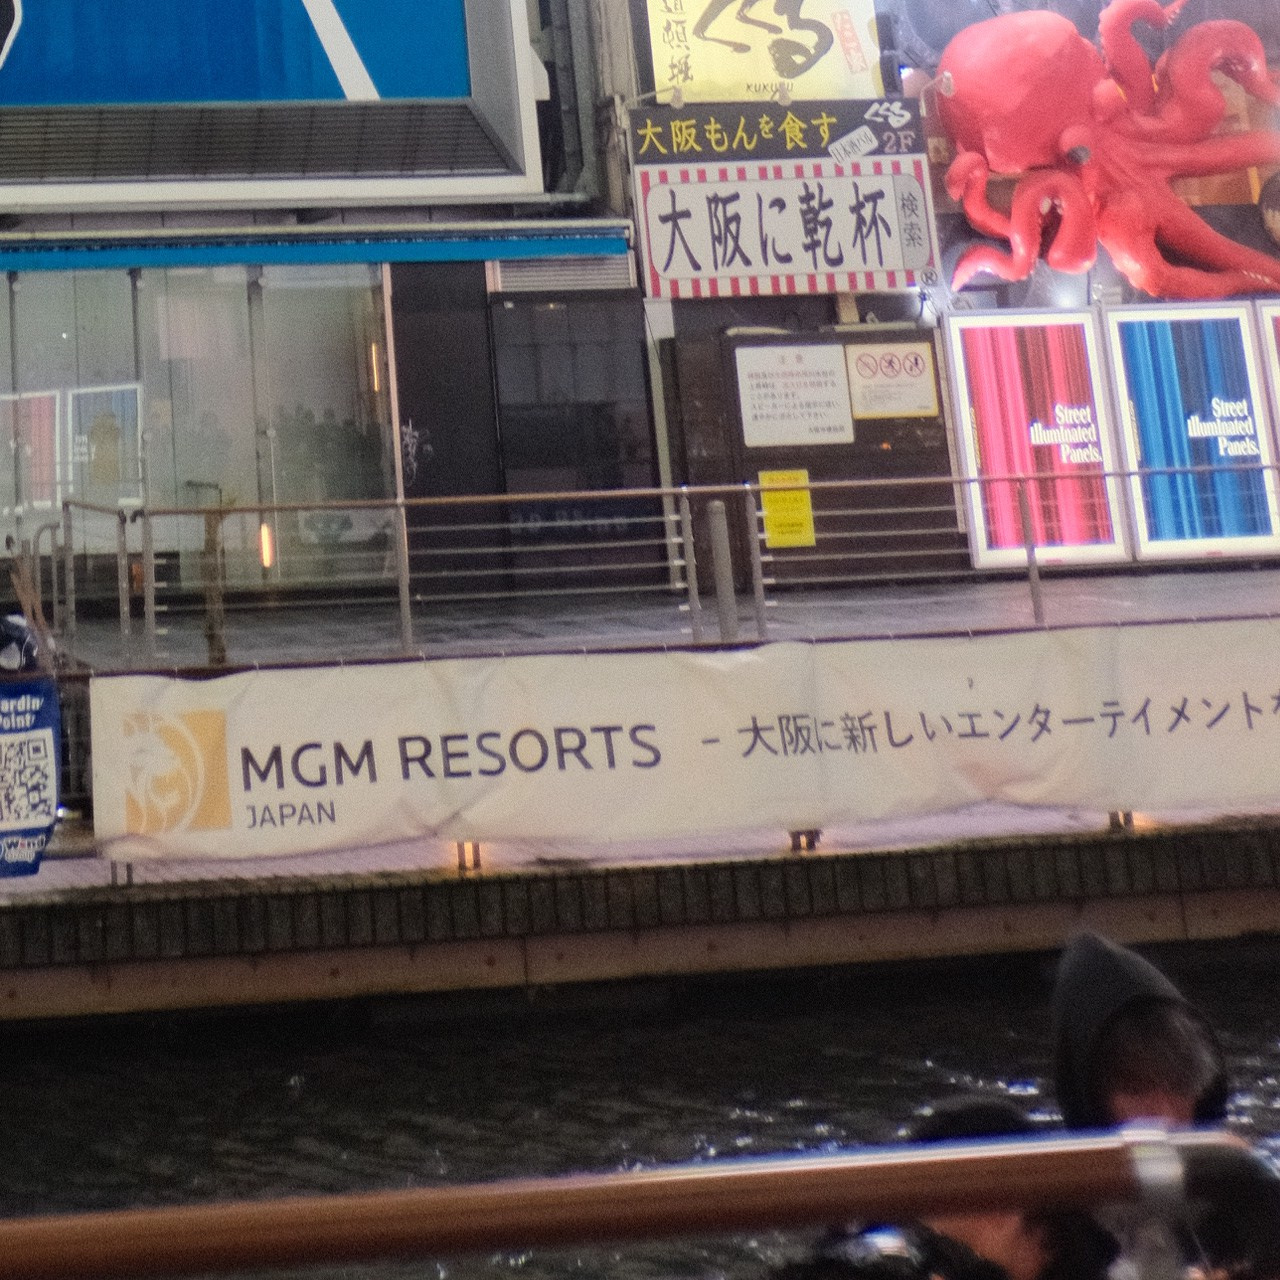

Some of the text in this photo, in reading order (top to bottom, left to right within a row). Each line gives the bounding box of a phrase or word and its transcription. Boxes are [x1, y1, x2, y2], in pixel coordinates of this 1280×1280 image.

[746, 82, 794, 94] KUKUU
[637, 111, 837, 155] 大阪もんを食す
[882, 131, 916, 154] 2F
[658, 181, 892, 273] 大阪に乾杯
[900, 192, 923, 249] 検索
[1055, 403, 1092, 425] Street
[1212, 396, 1248, 418] Street
[1061, 443, 1102, 464] Panels.
[1217, 436, 1259, 458] Panels.
[240, 722, 662, 793] MGM RESORTS
[246, 799, 337, 831] JAPAN
